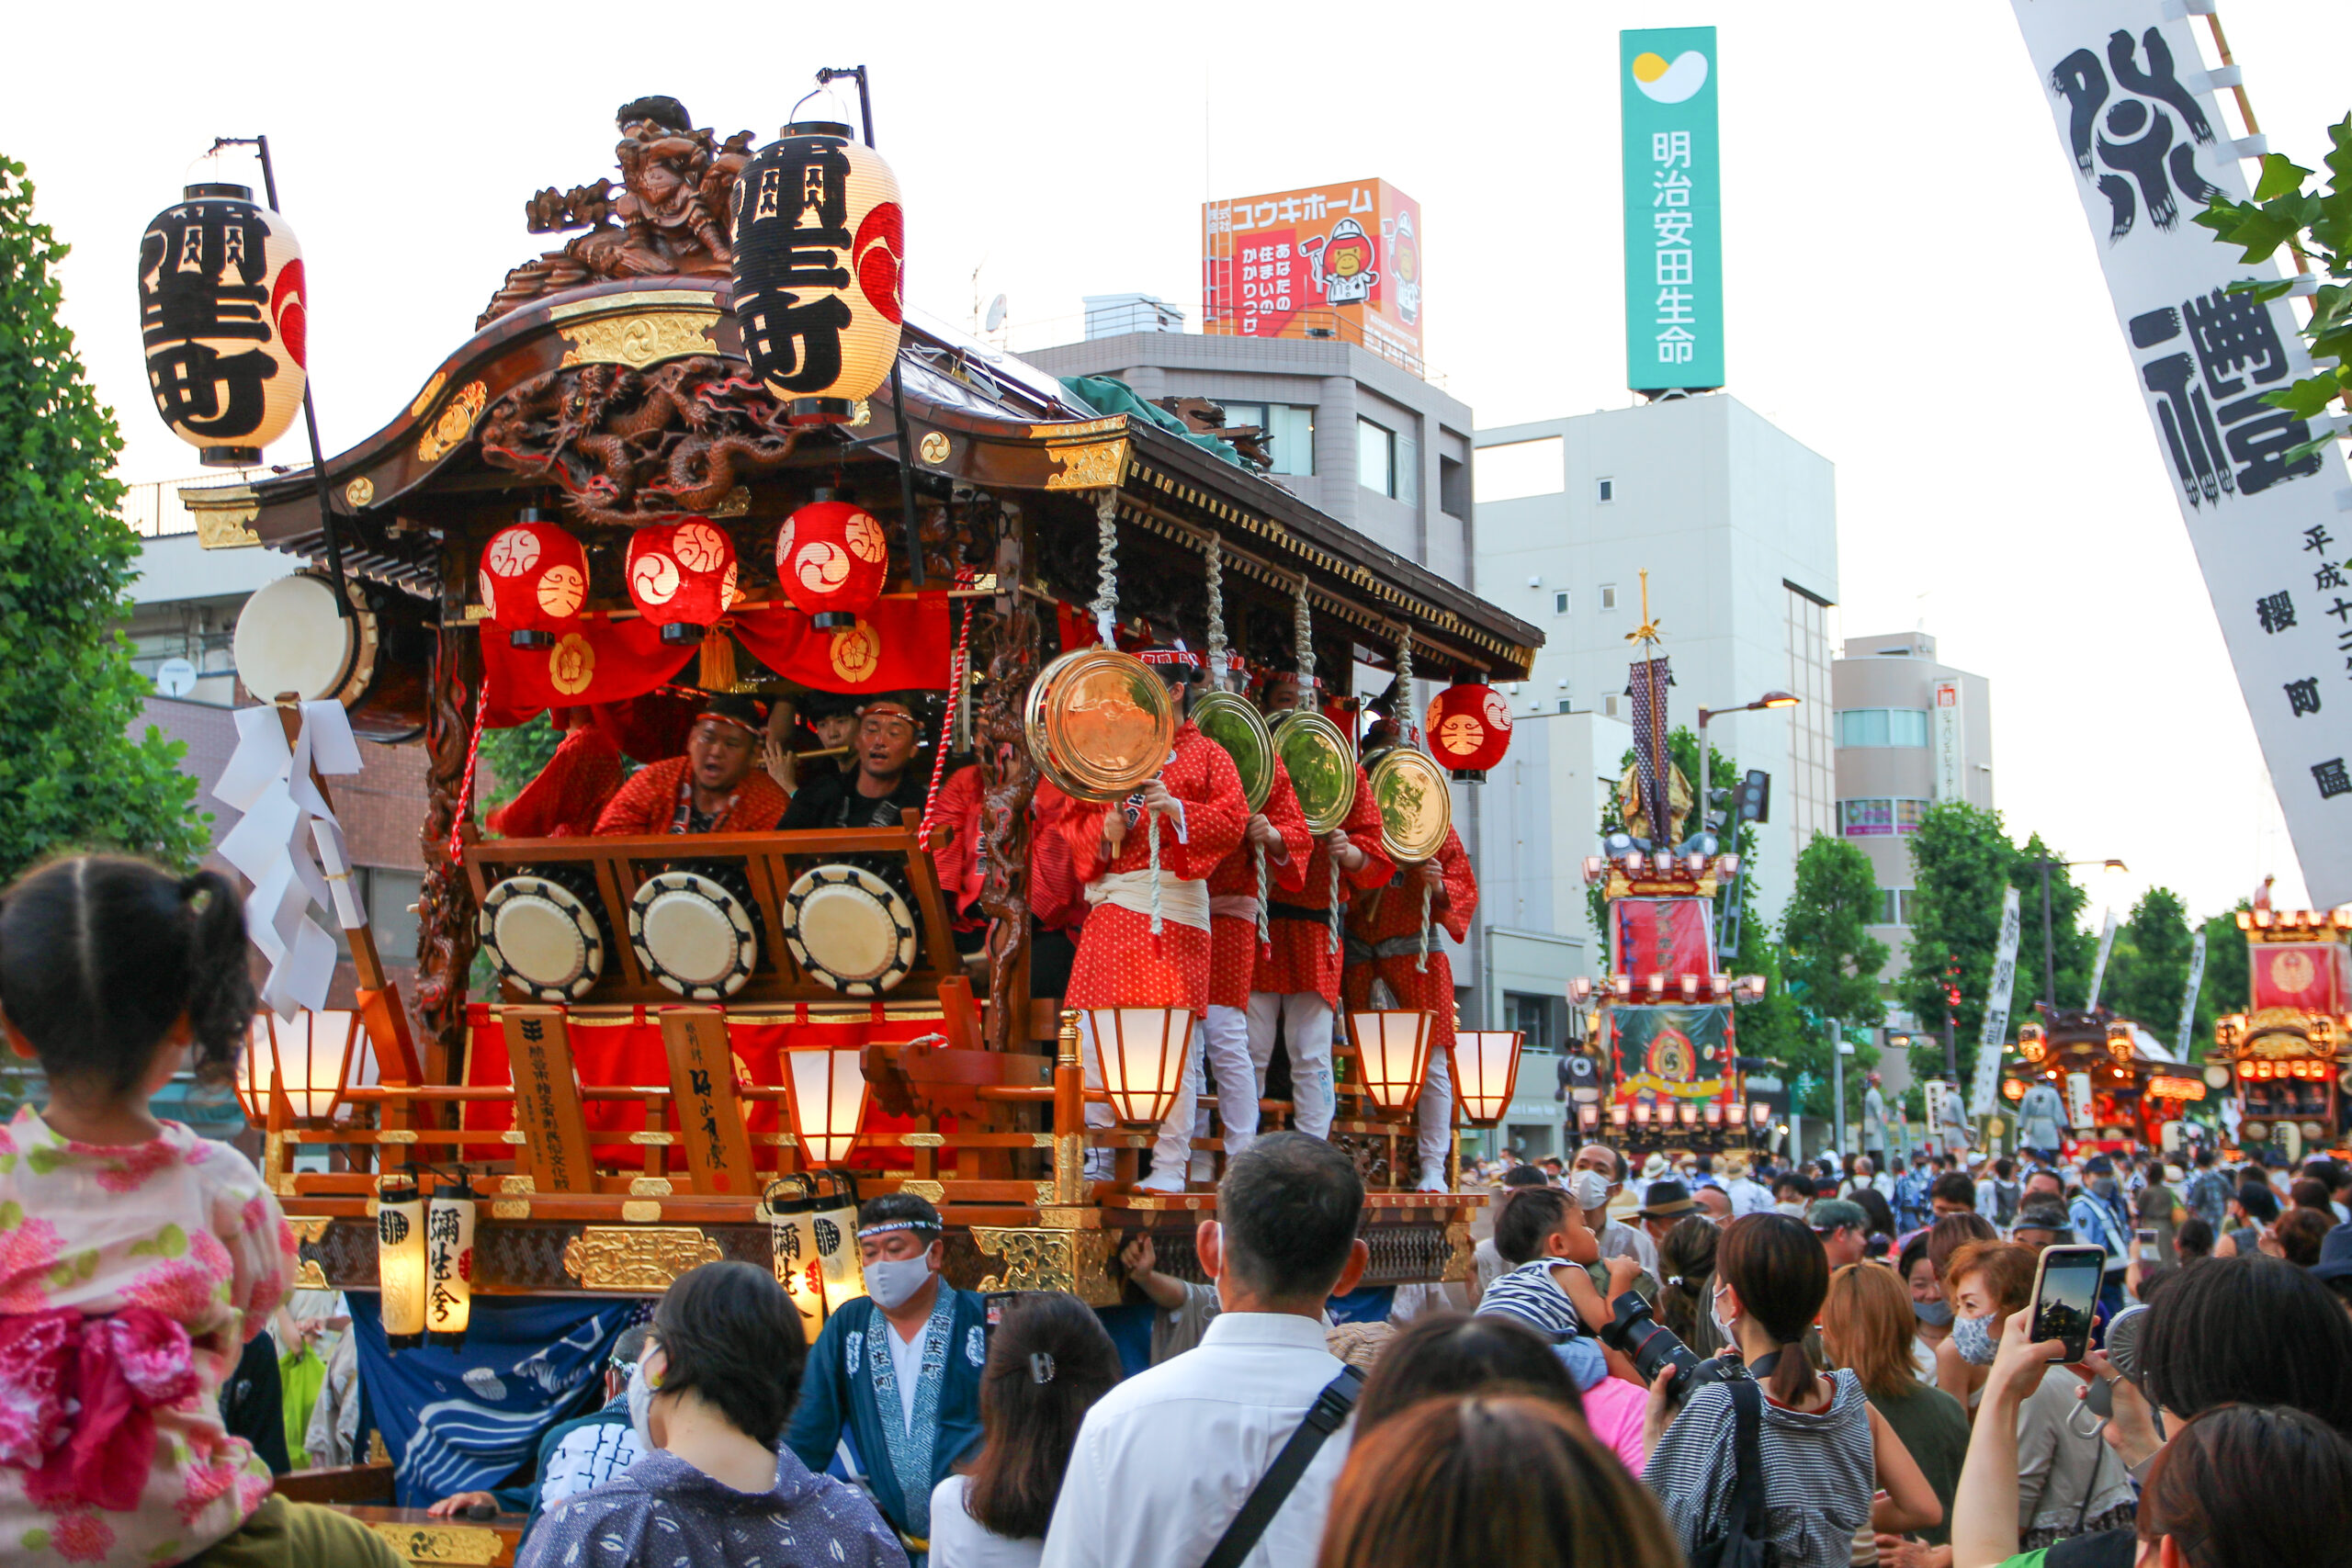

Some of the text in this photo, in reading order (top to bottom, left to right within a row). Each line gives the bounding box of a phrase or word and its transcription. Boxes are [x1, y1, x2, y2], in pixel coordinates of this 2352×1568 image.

[1232, 187, 1373, 231] ユウキホーム
[1259, 246, 1274, 315] 住まいの
[1275, 243, 1291, 311] あなたの
[1653, 130, 1696, 365] 明治安田生命
[1242, 248, 1259, 337] かかりつけ
